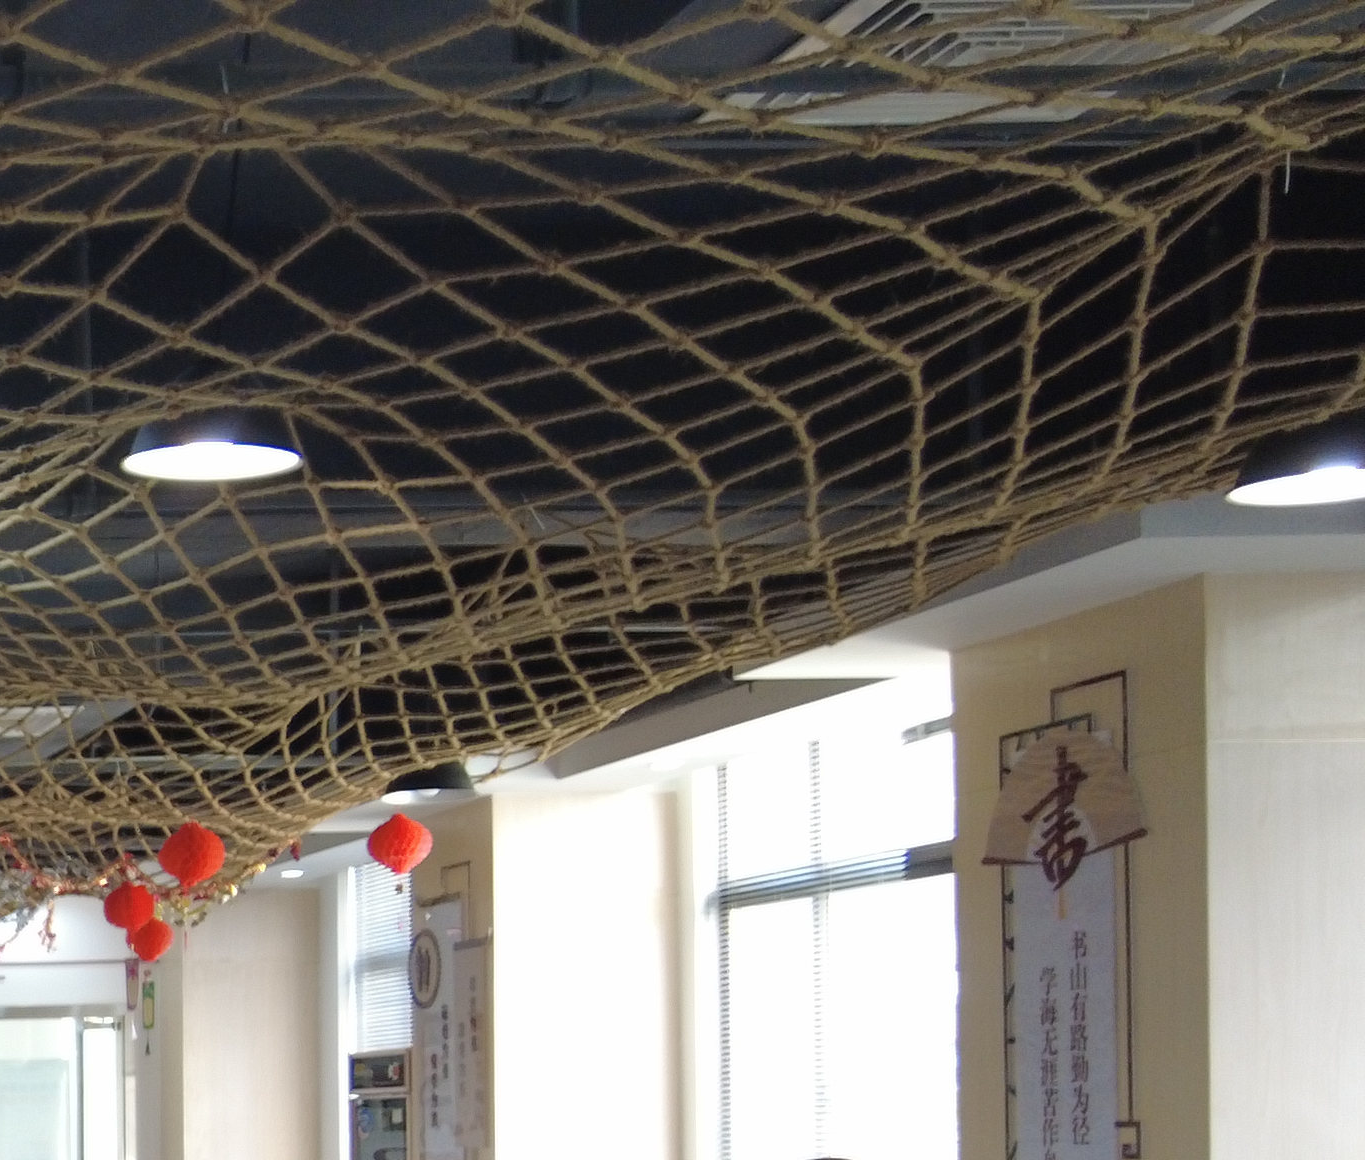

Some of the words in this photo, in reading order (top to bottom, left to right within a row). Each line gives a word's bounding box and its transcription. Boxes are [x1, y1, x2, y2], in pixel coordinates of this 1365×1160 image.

[1069, 930, 1090, 1146] 书山有路勤为径
